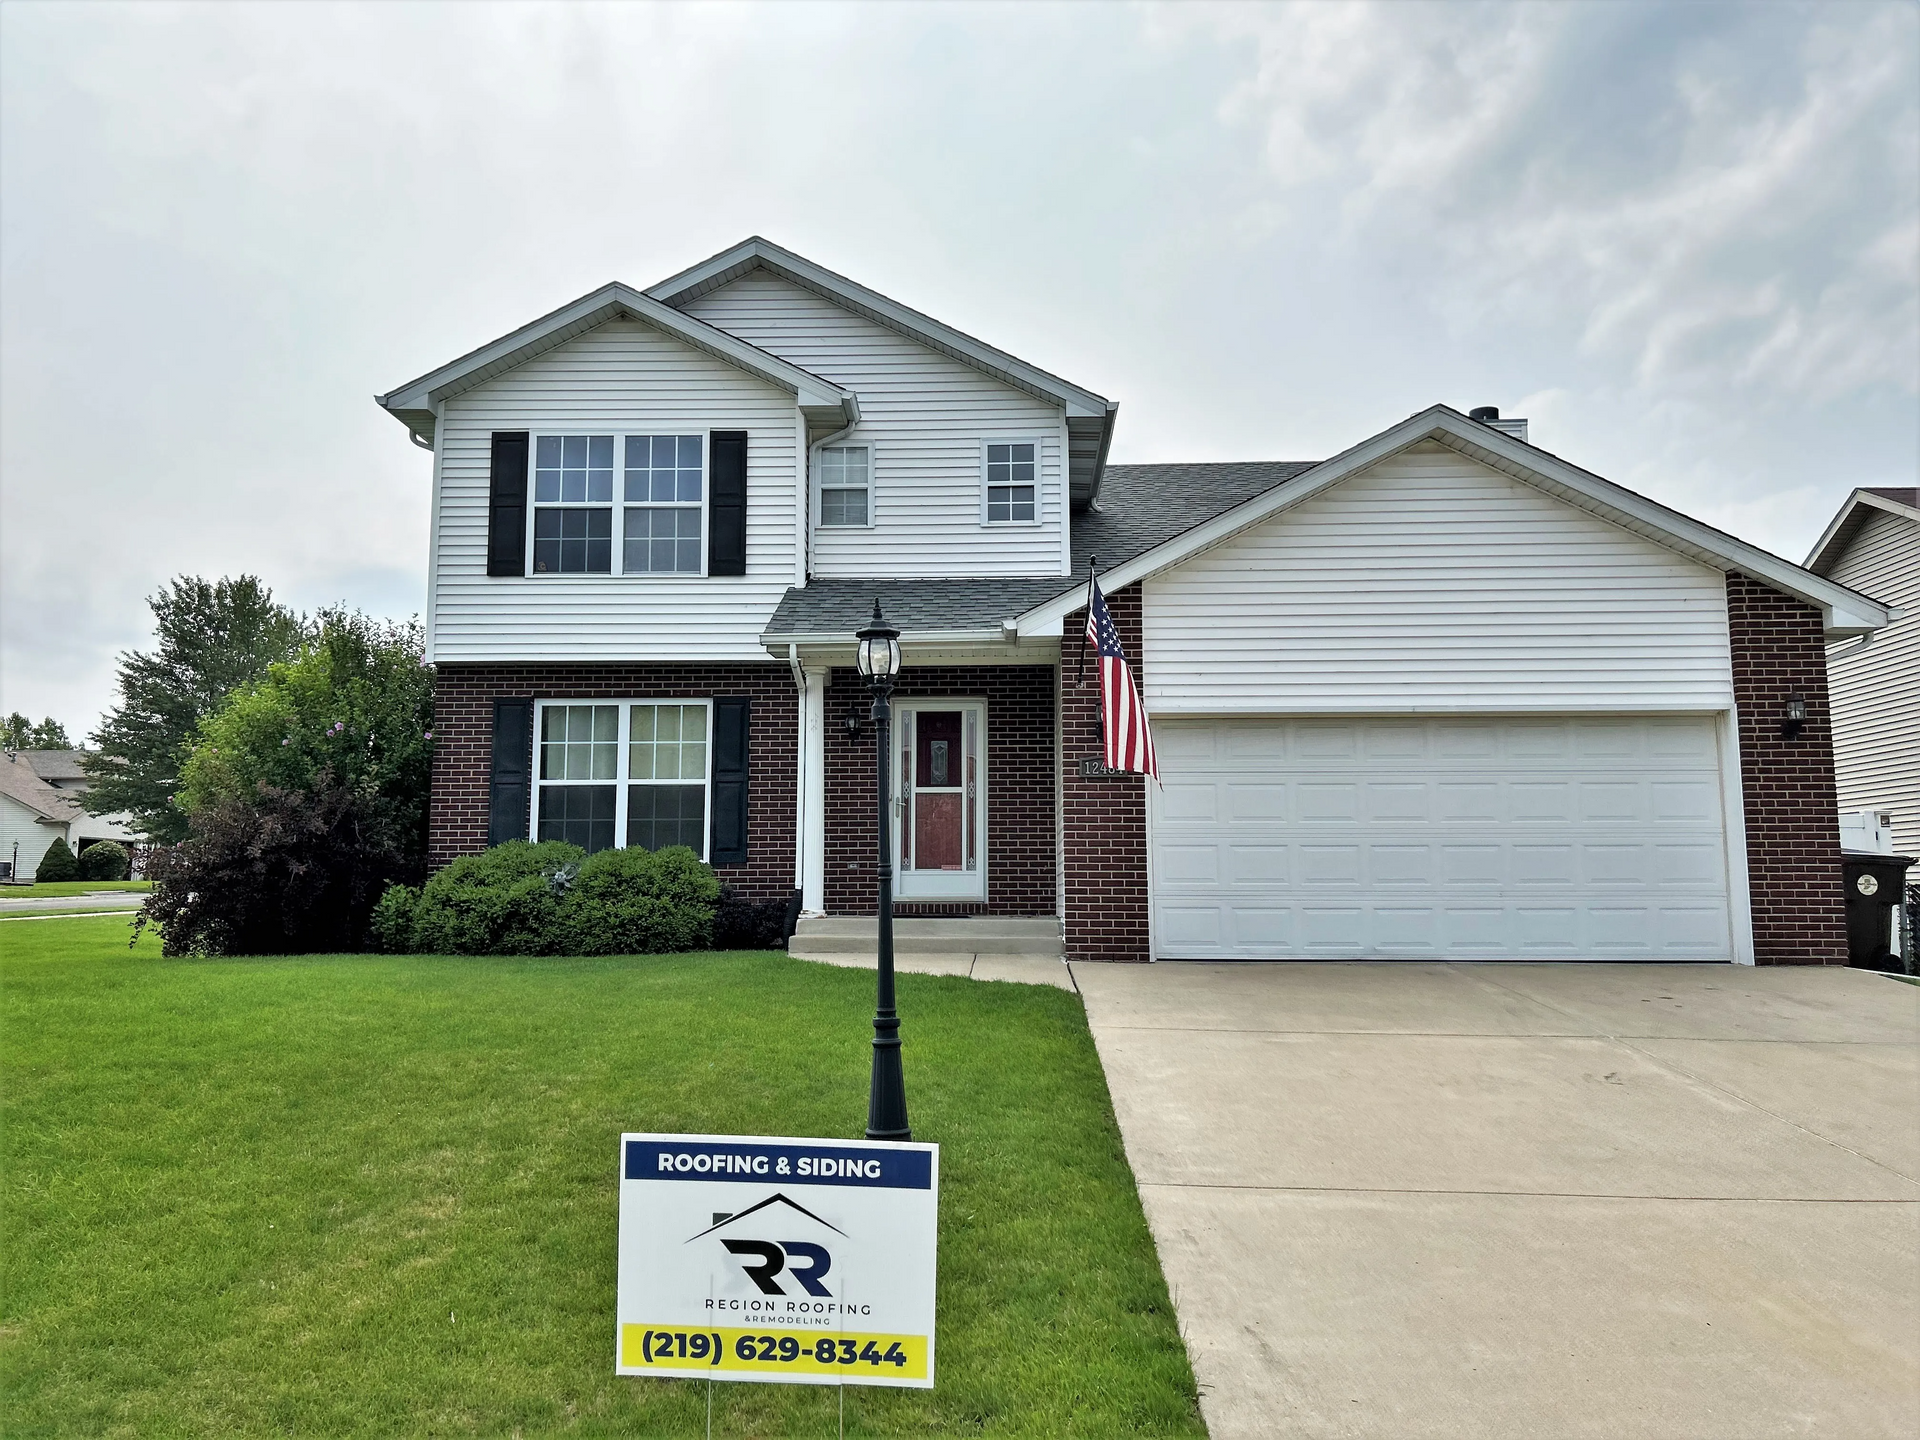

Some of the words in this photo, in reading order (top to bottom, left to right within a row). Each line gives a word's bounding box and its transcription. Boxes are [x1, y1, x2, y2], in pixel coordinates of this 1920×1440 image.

[1085, 761, 1124, 775] 124
[658, 1153, 769, 1174] ROOFING
[775, 1157, 791, 1175] &
[796, 1157, 881, 1179] SIDING
[719, 1238, 834, 1298] RR
[705, 1298, 776, 1312] REGION
[786, 1301, 872, 1316] ROOFING
[744, 1315, 831, 1326] &REMODELING
[642, 1330, 723, 1365] (219)
[735, 1335, 907, 1367] 629-8344
